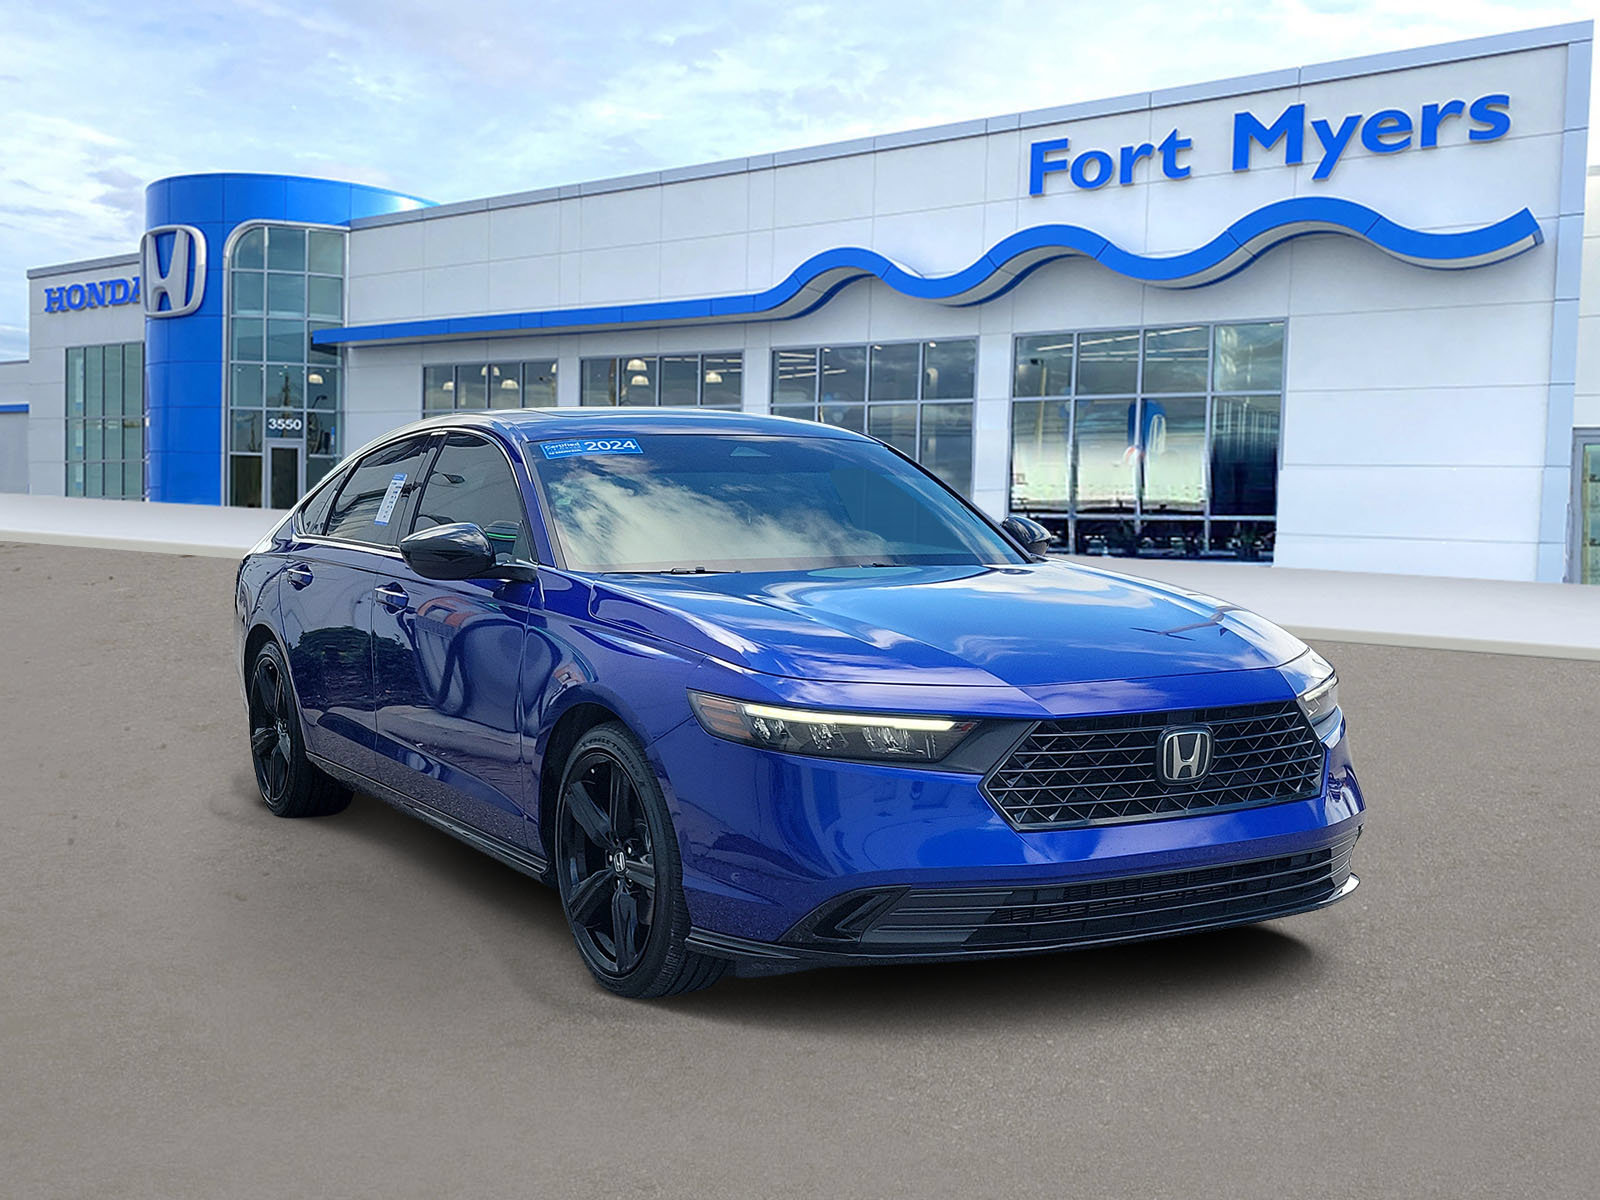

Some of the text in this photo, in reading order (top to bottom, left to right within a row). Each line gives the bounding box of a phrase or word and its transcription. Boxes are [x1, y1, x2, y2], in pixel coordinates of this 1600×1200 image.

[1029, 94, 1512, 196] Fort Myers
[268, 418, 302, 430] 3550
[584, 440, 637, 451] 2024
